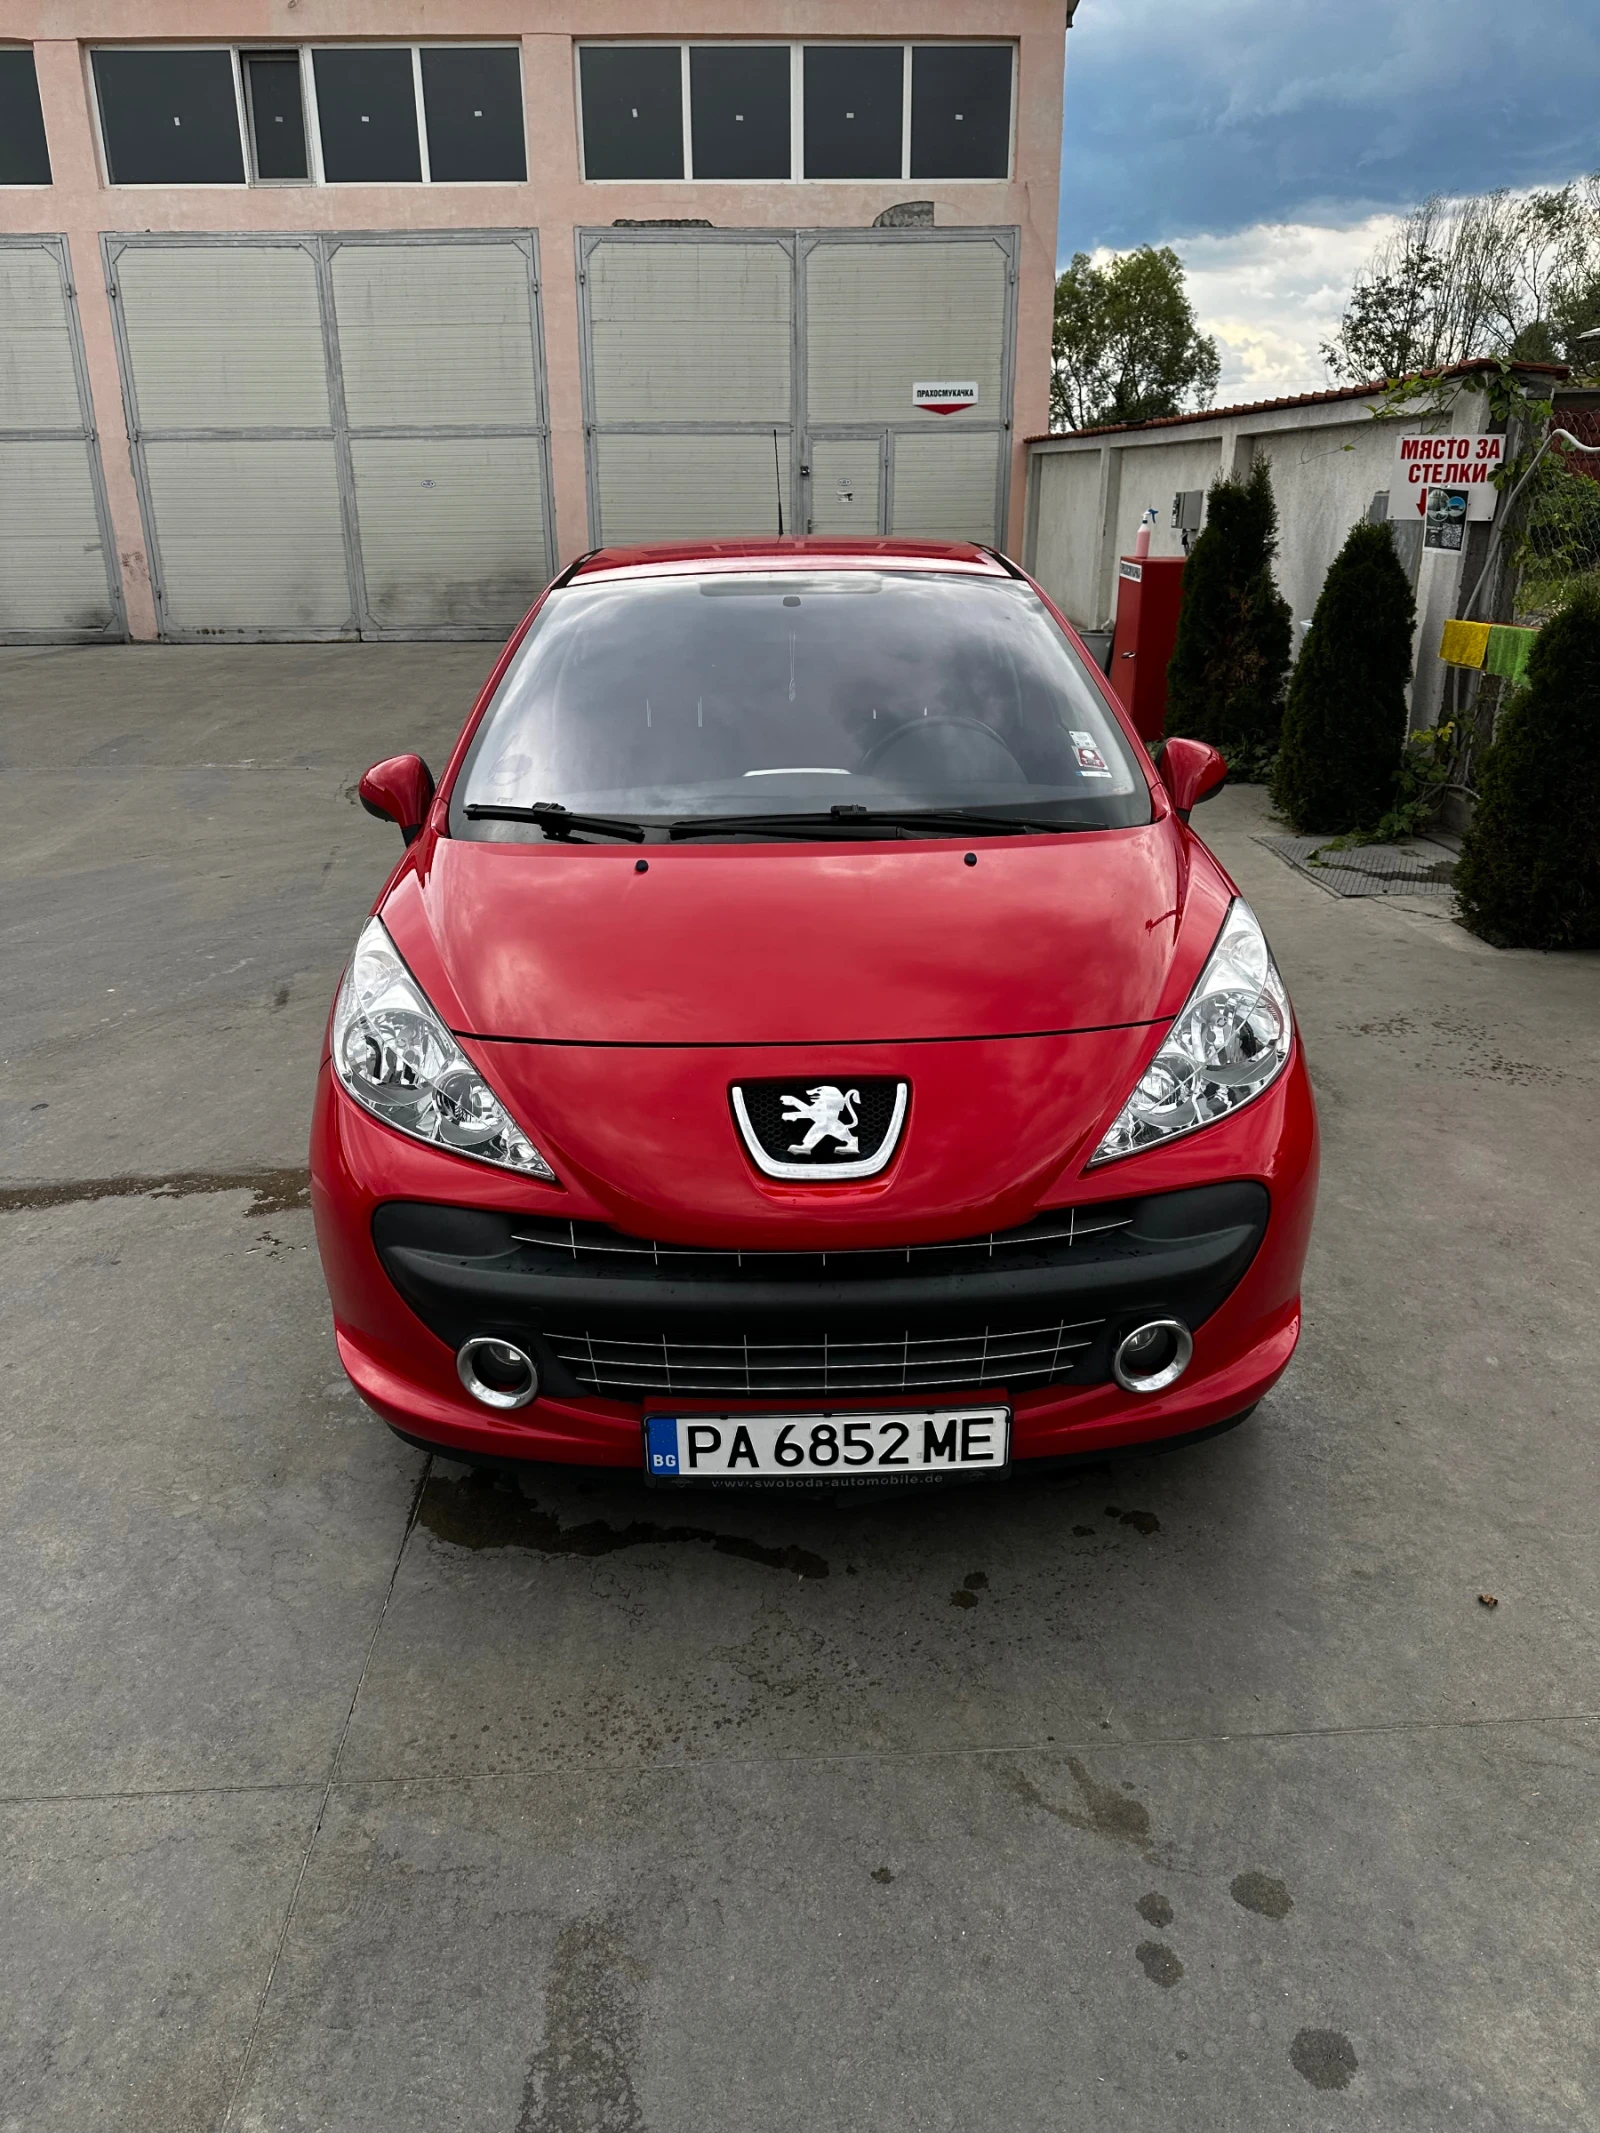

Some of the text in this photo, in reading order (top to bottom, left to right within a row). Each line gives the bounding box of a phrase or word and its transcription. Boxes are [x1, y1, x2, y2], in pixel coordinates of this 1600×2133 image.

[916, 389, 974, 398] ПРАХОСМУКАЧКА
[1400, 438, 1500, 460] МЯСТО ЗА
[1408, 463, 1488, 483] СТЕЛКИ
[687, 1417, 994, 1468] PA 6852 ME
[653, 1454, 676, 1467] BG
